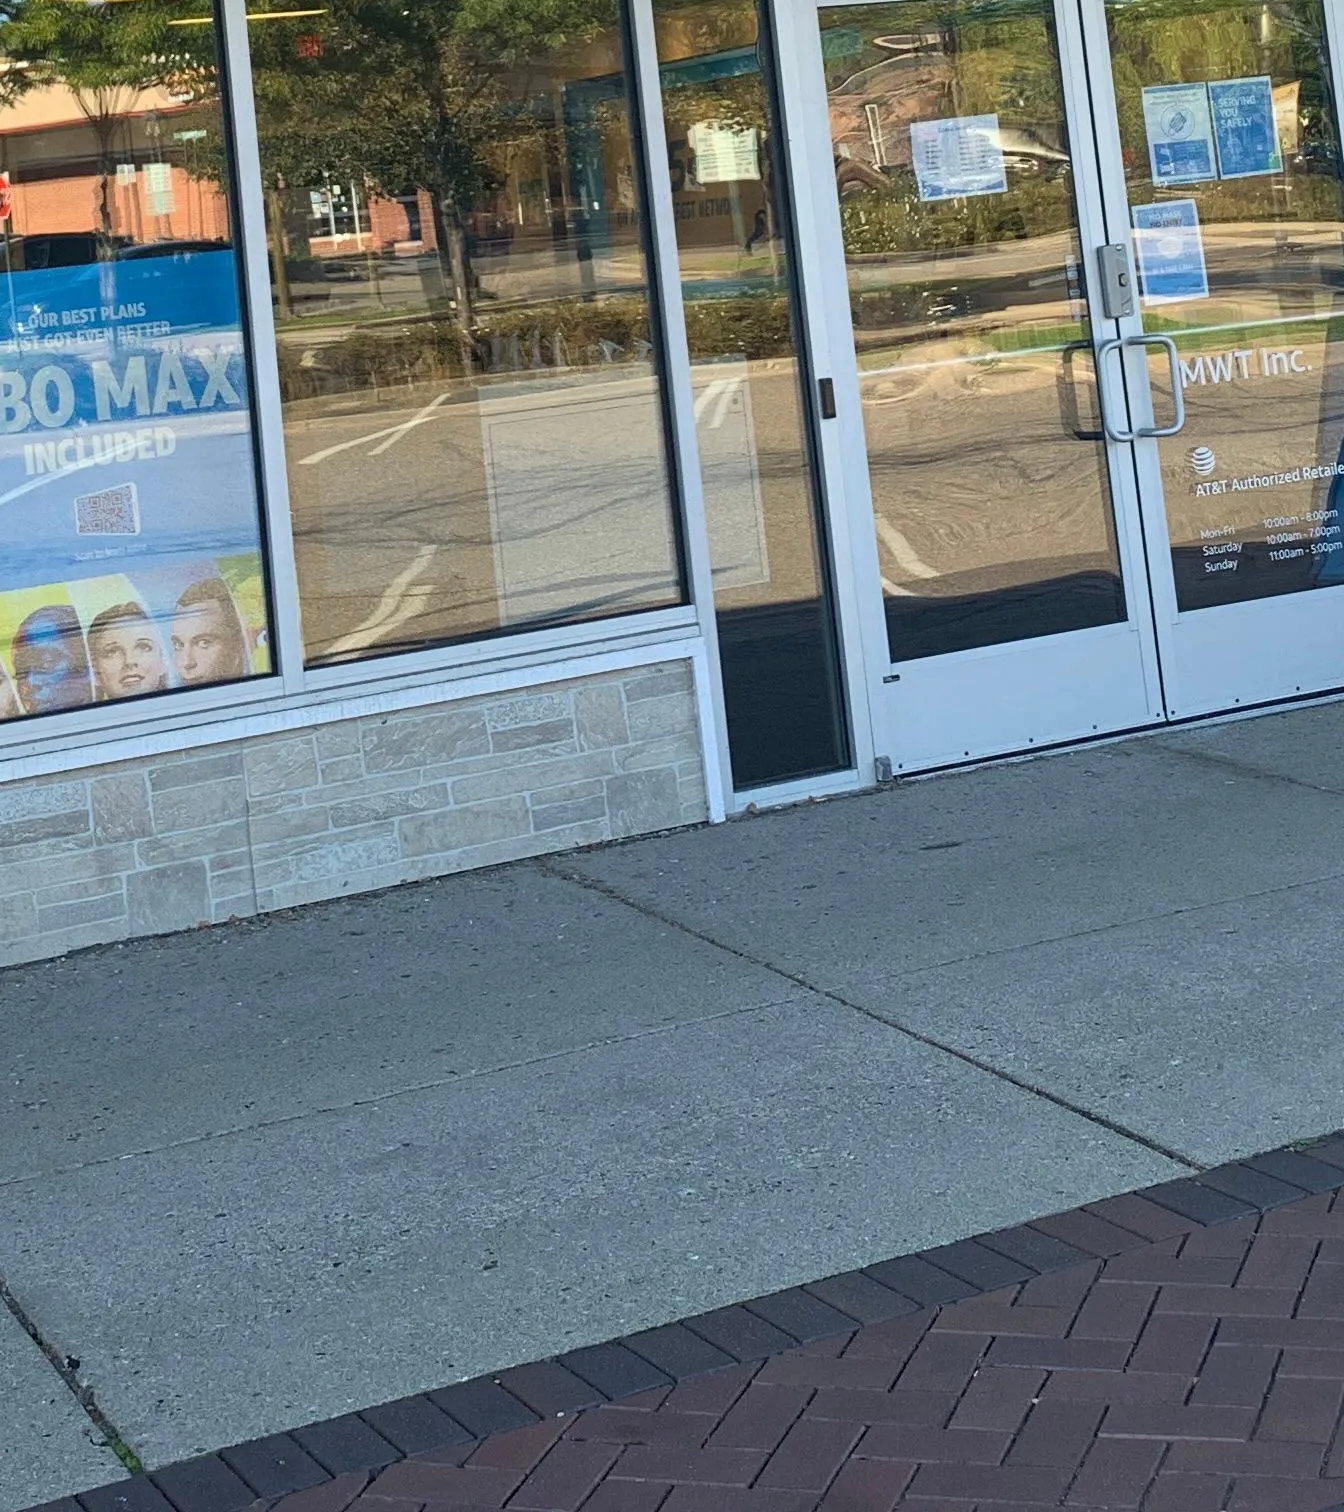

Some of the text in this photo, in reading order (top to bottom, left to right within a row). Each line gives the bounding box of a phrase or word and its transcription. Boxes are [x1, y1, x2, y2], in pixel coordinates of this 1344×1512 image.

[1217, 95, 1257, 107] SERVING
[1219, 108, 1238, 118] YOU
[1221, 116, 1253, 128] SAFELY
[27, 302, 147, 329] OUR BEST PLANS
[44, 331, 73, 349] GOT
[76, 326, 113, 344] EVEN
[117, 320, 171, 339] BETTER
[1179, 347, 1314, 388] MWT Inc.
[92, 350, 242, 422] MAX
[23, 424, 177, 476] INCLUDED
[1195, 479, 1228, 498] AT&T
[1231, 467, 1301, 491] Authorized
[1200, 524, 1236, 540] Mon-Fri
[1262, 515, 1300, 530] 10:00am
[1202, 541, 1244, 557] Saturday
[1265, 531, 1303, 546] 10:00am
[1308, 524, 1341, 539] 7:00pm
[1205, 558, 1239, 574] Sunday
[1268, 548, 1305, 562] 11:00am
[1310, 540, 1344, 556] 5:00pm
